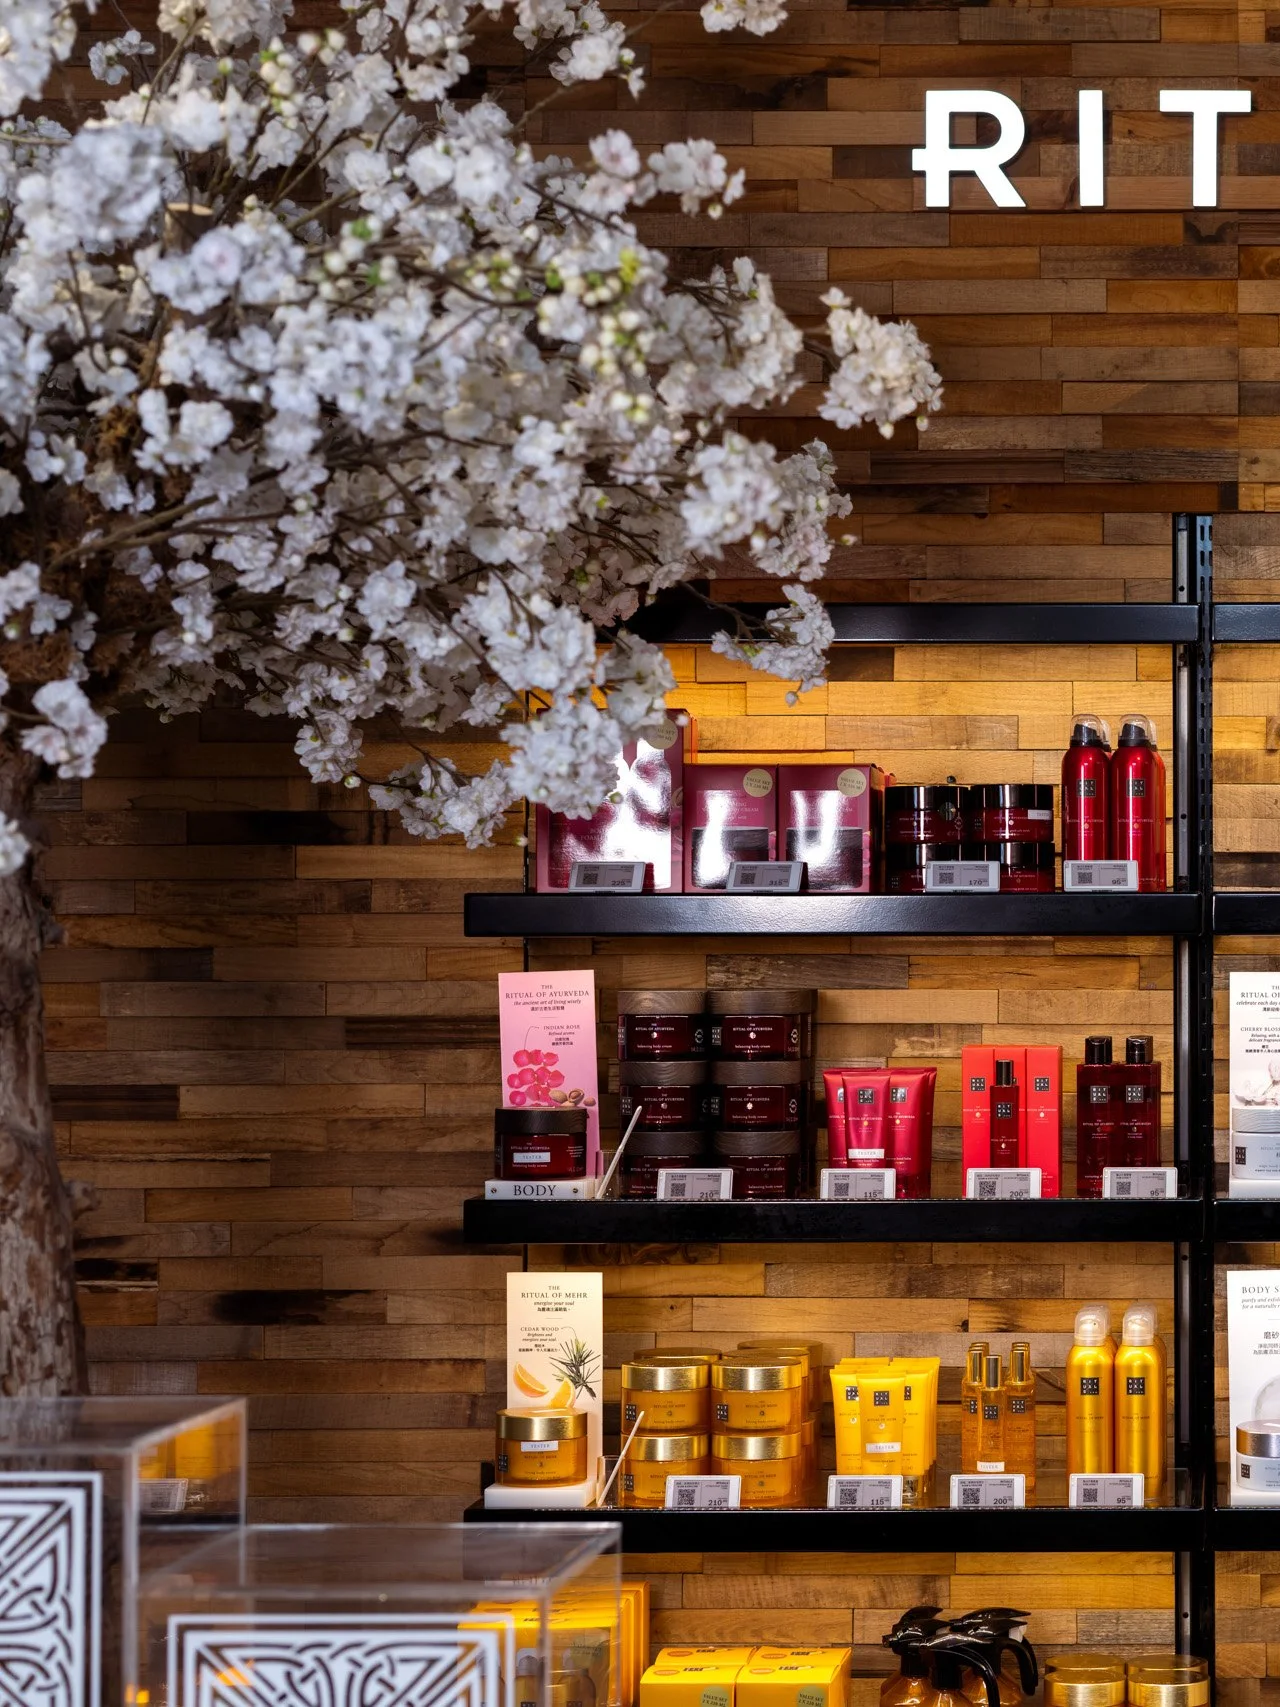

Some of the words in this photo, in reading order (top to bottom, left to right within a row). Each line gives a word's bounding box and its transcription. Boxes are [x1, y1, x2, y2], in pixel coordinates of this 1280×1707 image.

[505, 991, 534, 999] RITUAL
[549, 990, 590, 998] AYURVEDA
[513, 1184, 557, 1197] BODY
[1241, 1286, 1270, 1294] BODY
[703, 1693, 718, 1701] VALUE
